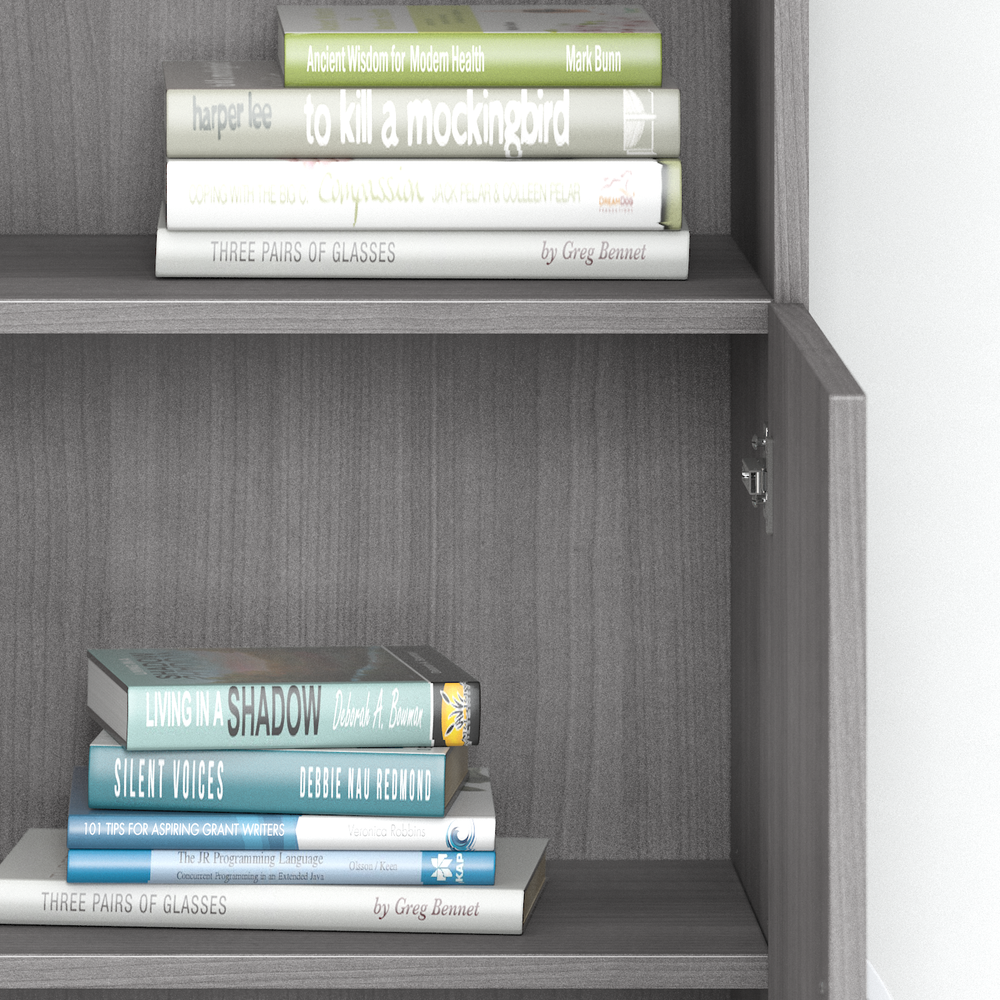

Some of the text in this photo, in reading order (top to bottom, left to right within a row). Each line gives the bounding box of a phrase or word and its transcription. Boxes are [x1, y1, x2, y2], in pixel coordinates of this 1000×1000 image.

[307, 45, 485, 73] Ancient Wisdom for Modern Health
[566, 44, 621, 72] Mark Bunn
[193, 91, 272, 140] harper lee
[304, 89, 570, 158] to kill a mockingbird
[230, 184, 254, 205] WITH
[258, 184, 276, 205] THE
[210, 240, 396, 263] THREE PAIRS OF GLASSES
[540, 240, 647, 265] by Greg Bennet
[146, 685, 321, 737] LIVING IN A SHADOW
[332, 689, 370, 731] Deborah
[388, 687, 424, 729] Bowman
[114, 757, 224, 801] SILENT VOICES
[300, 766, 432, 802] DEBBIE NAU REDMOND
[84, 822, 285, 837] 101 TIPS FOR ASPIRING GRANT WRITERS
[347, 824, 427, 838] Veronica Robbins
[178, 851, 324, 868] The JR Programming Language
[42, 892, 227, 916] THREE PAIRS OF GLASSES
[373, 897, 480, 921] by Greg Bennet
